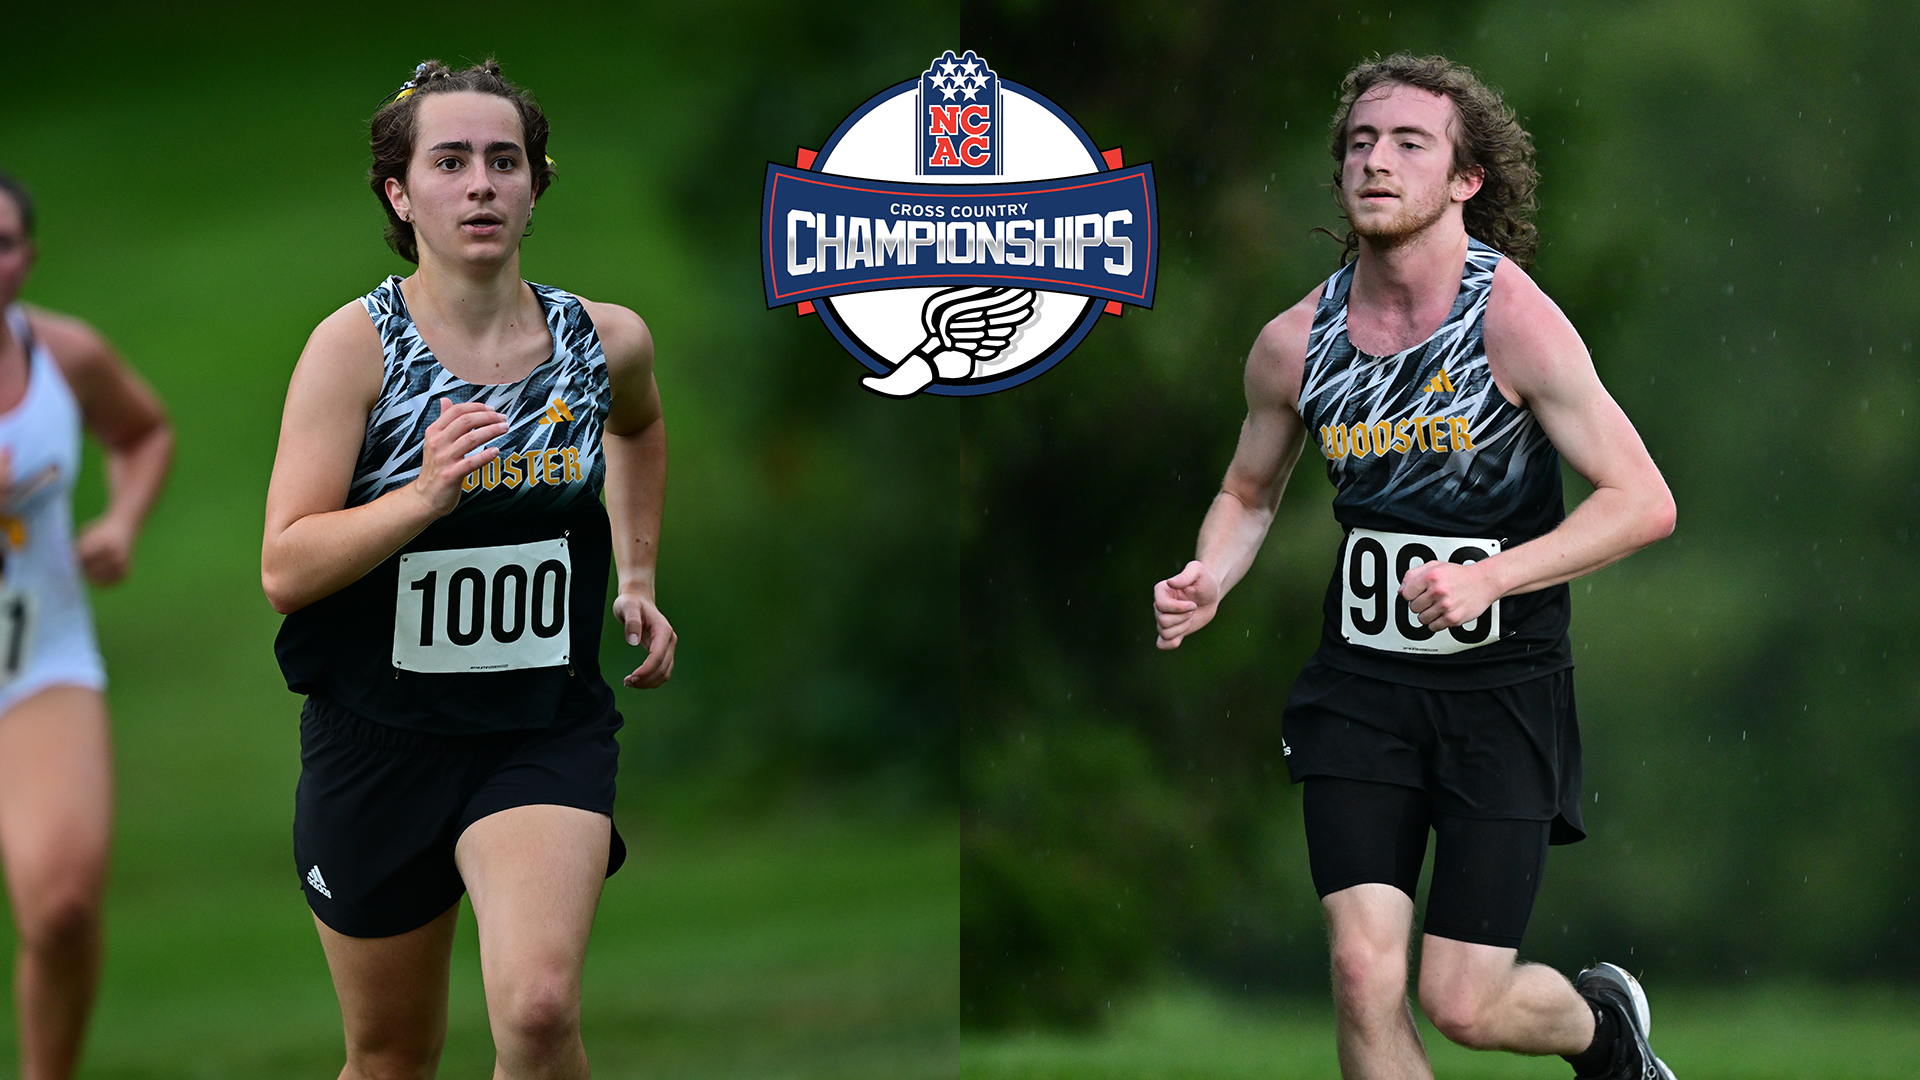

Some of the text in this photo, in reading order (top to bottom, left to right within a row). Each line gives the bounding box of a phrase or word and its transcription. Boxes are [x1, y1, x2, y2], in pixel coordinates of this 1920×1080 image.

[1320, 415, 1476, 460] WOOSTER
[461, 445, 583, 493] OOSTER
[410, 559, 568, 647] 1000
